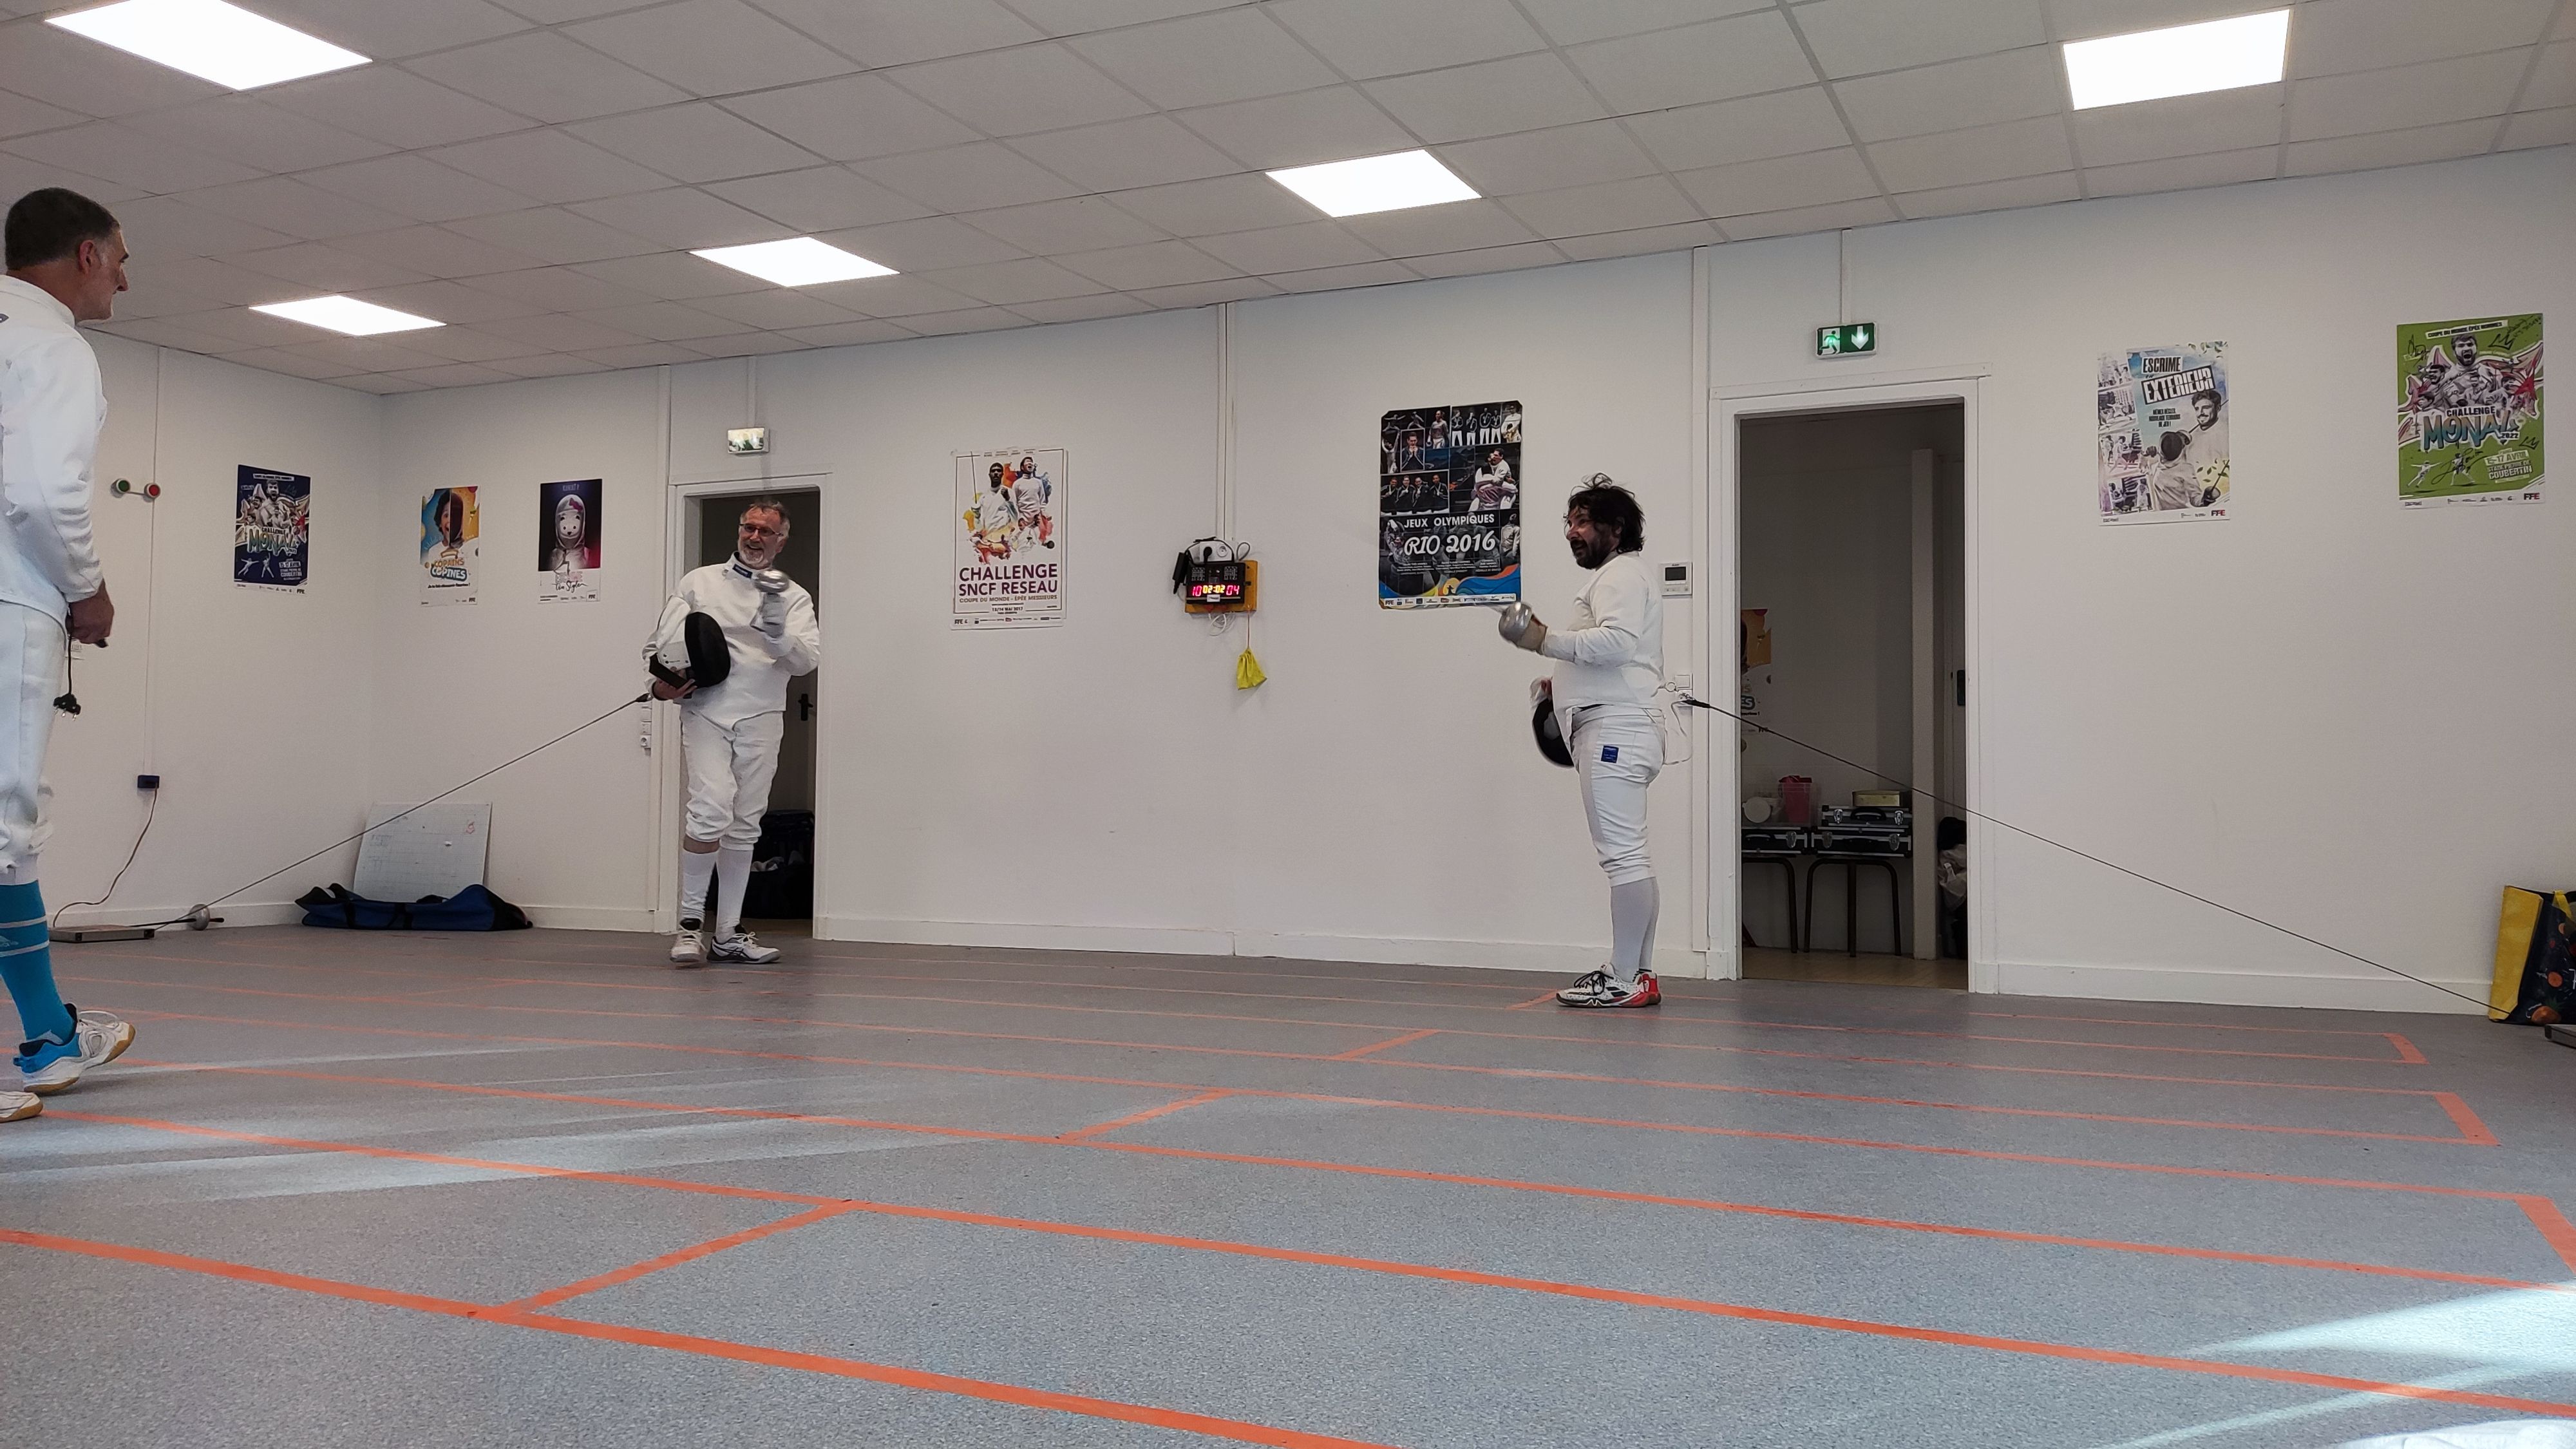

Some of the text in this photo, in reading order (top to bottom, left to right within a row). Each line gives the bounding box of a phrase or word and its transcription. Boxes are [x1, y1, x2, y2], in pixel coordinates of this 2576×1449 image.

[2143, 357, 2181, 373] ESCRIME
[2143, 368, 2214, 403] EXTERIEUR
[2447, 406, 2496, 417] CHALLENGE
[2489, 466, 2533, 480] COUBERTIN
[1404, 514, 1495, 528] JEUX OLYMPIQUES
[1404, 530, 1497, 556] RIO 2016
[434, 558, 464, 567] COPAINS
[431, 567, 466, 580] COPINES
[959, 563, 1058, 582] CHALLENGE
[959, 580, 1058, 596] SNCF RESEAU
[1192, 584, 1240, 597] 10 02:02 04
